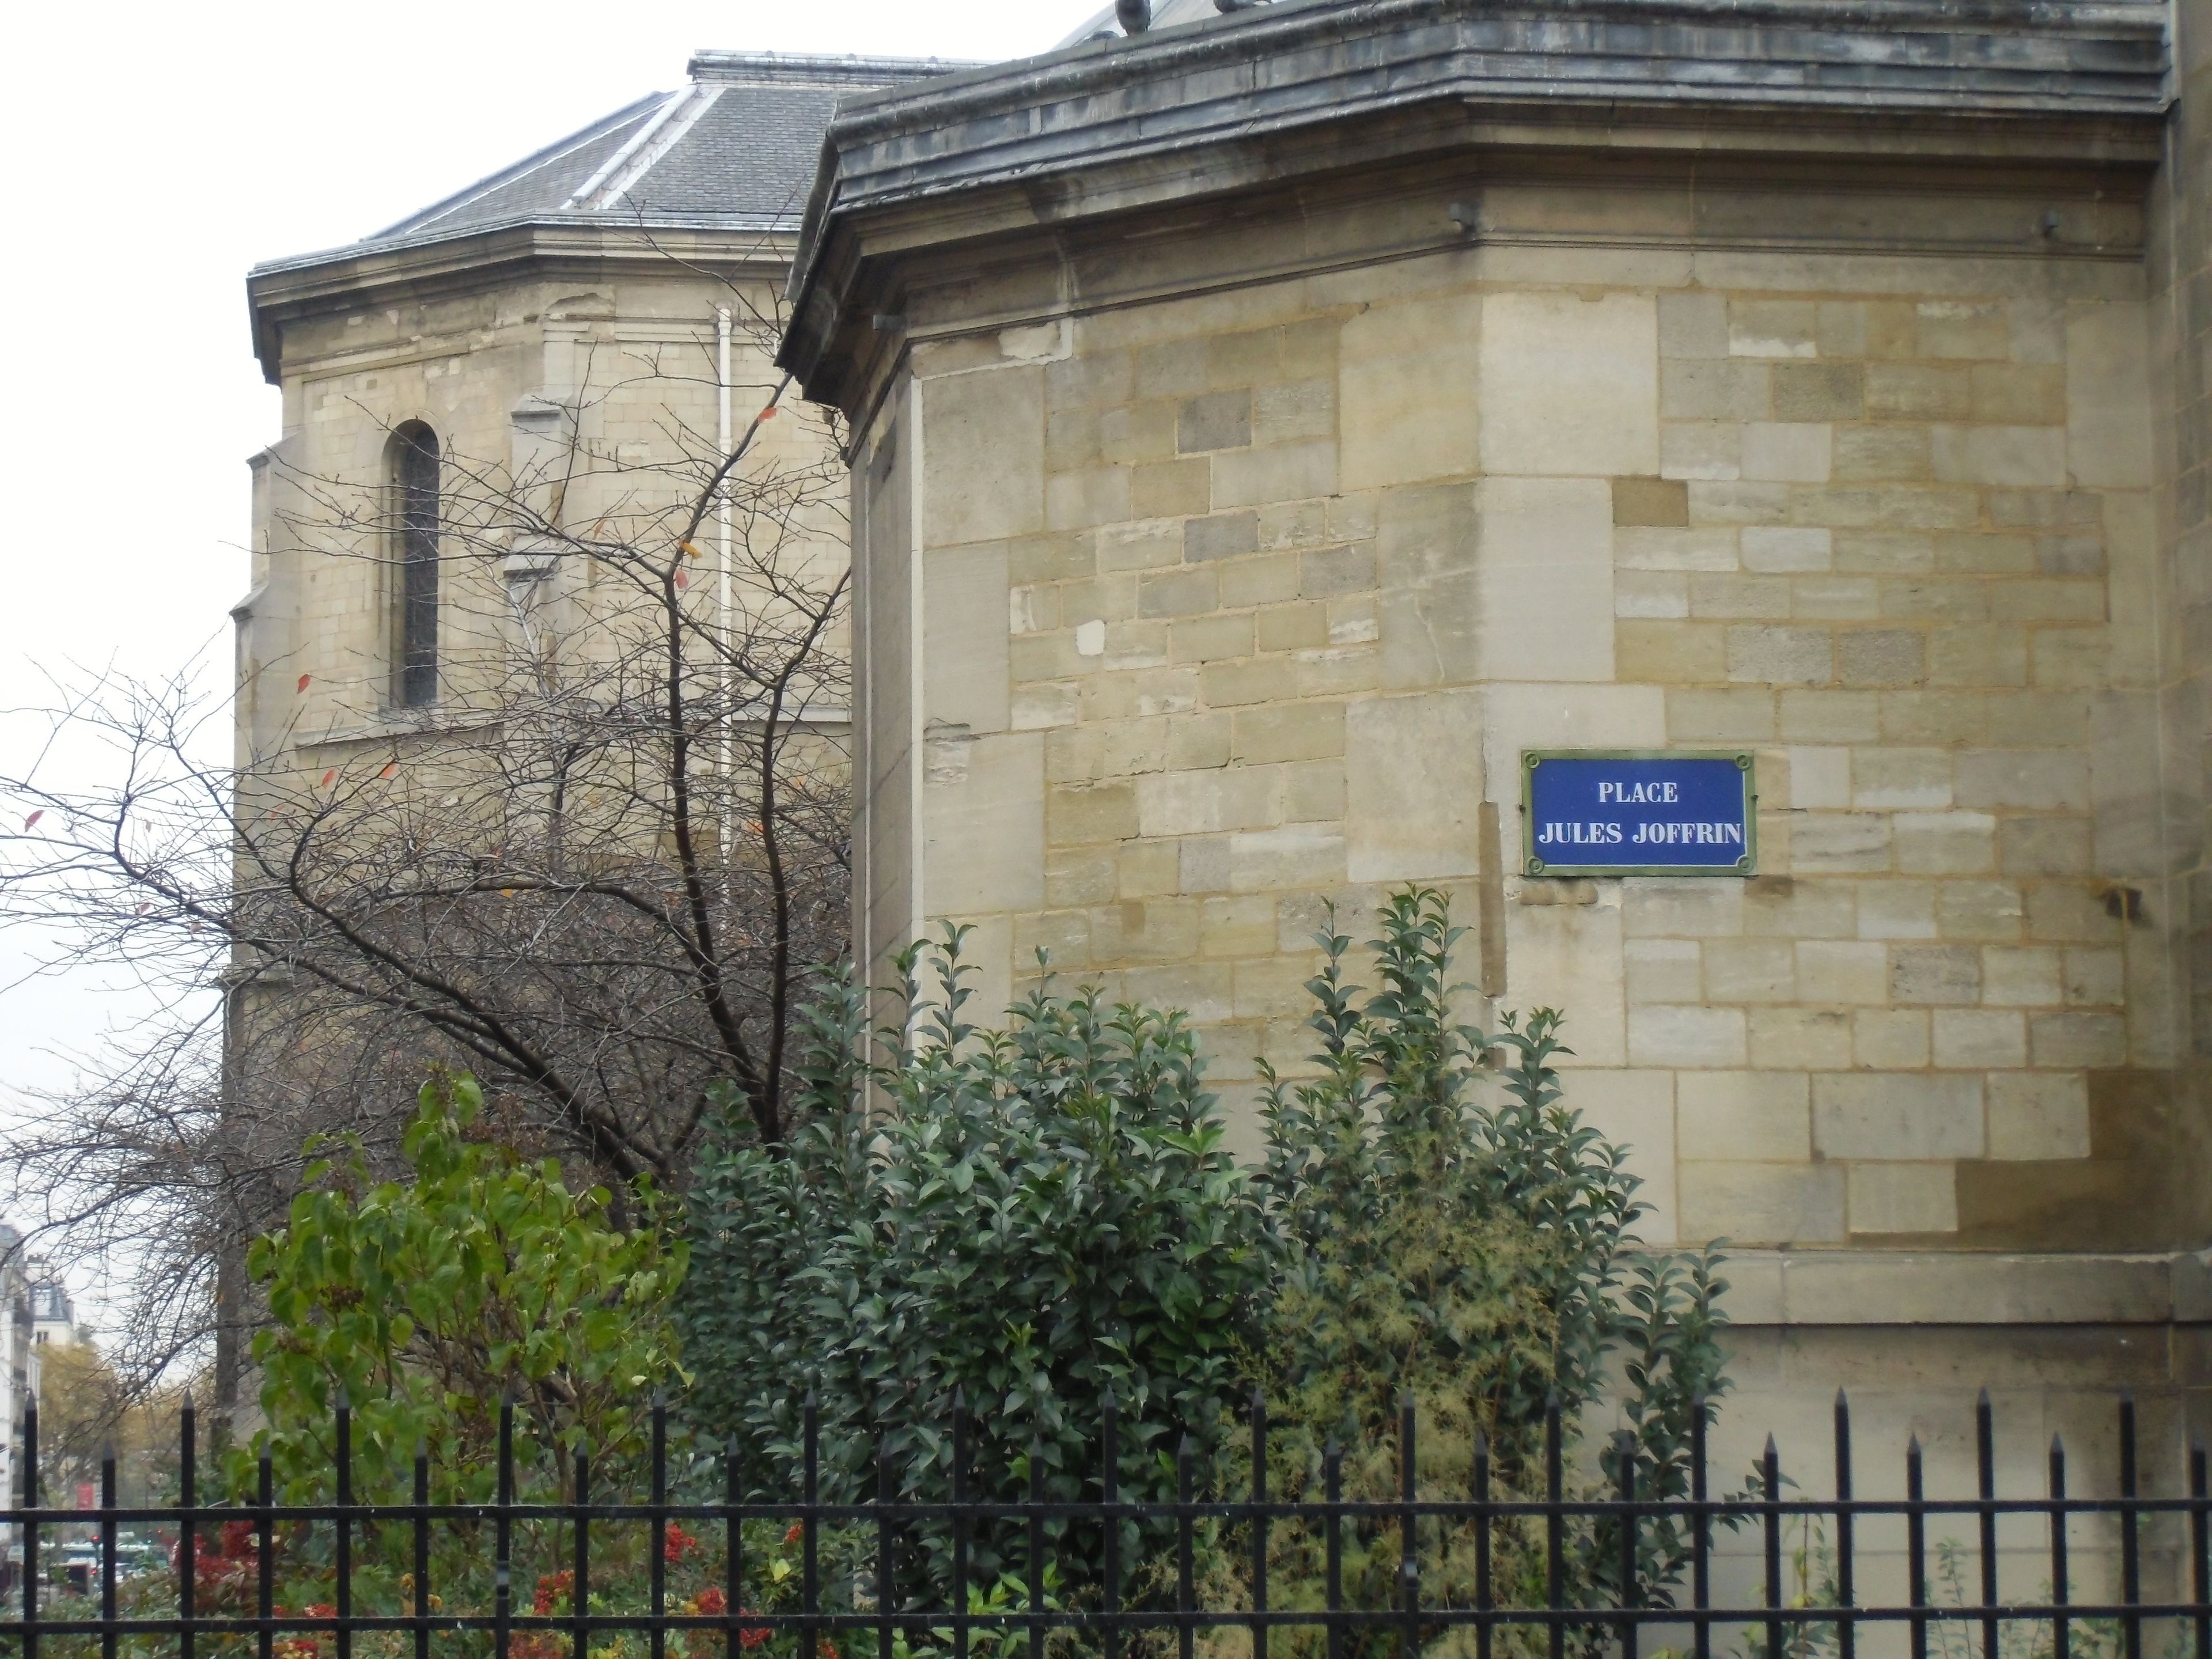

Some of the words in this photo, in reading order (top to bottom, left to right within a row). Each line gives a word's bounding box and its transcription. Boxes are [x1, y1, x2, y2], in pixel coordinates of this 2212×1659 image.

[1598, 782, 1678, 803] PLACE
[1539, 823, 1623, 844] JULES
[1632, 823, 1741, 844] JOFFRIN
